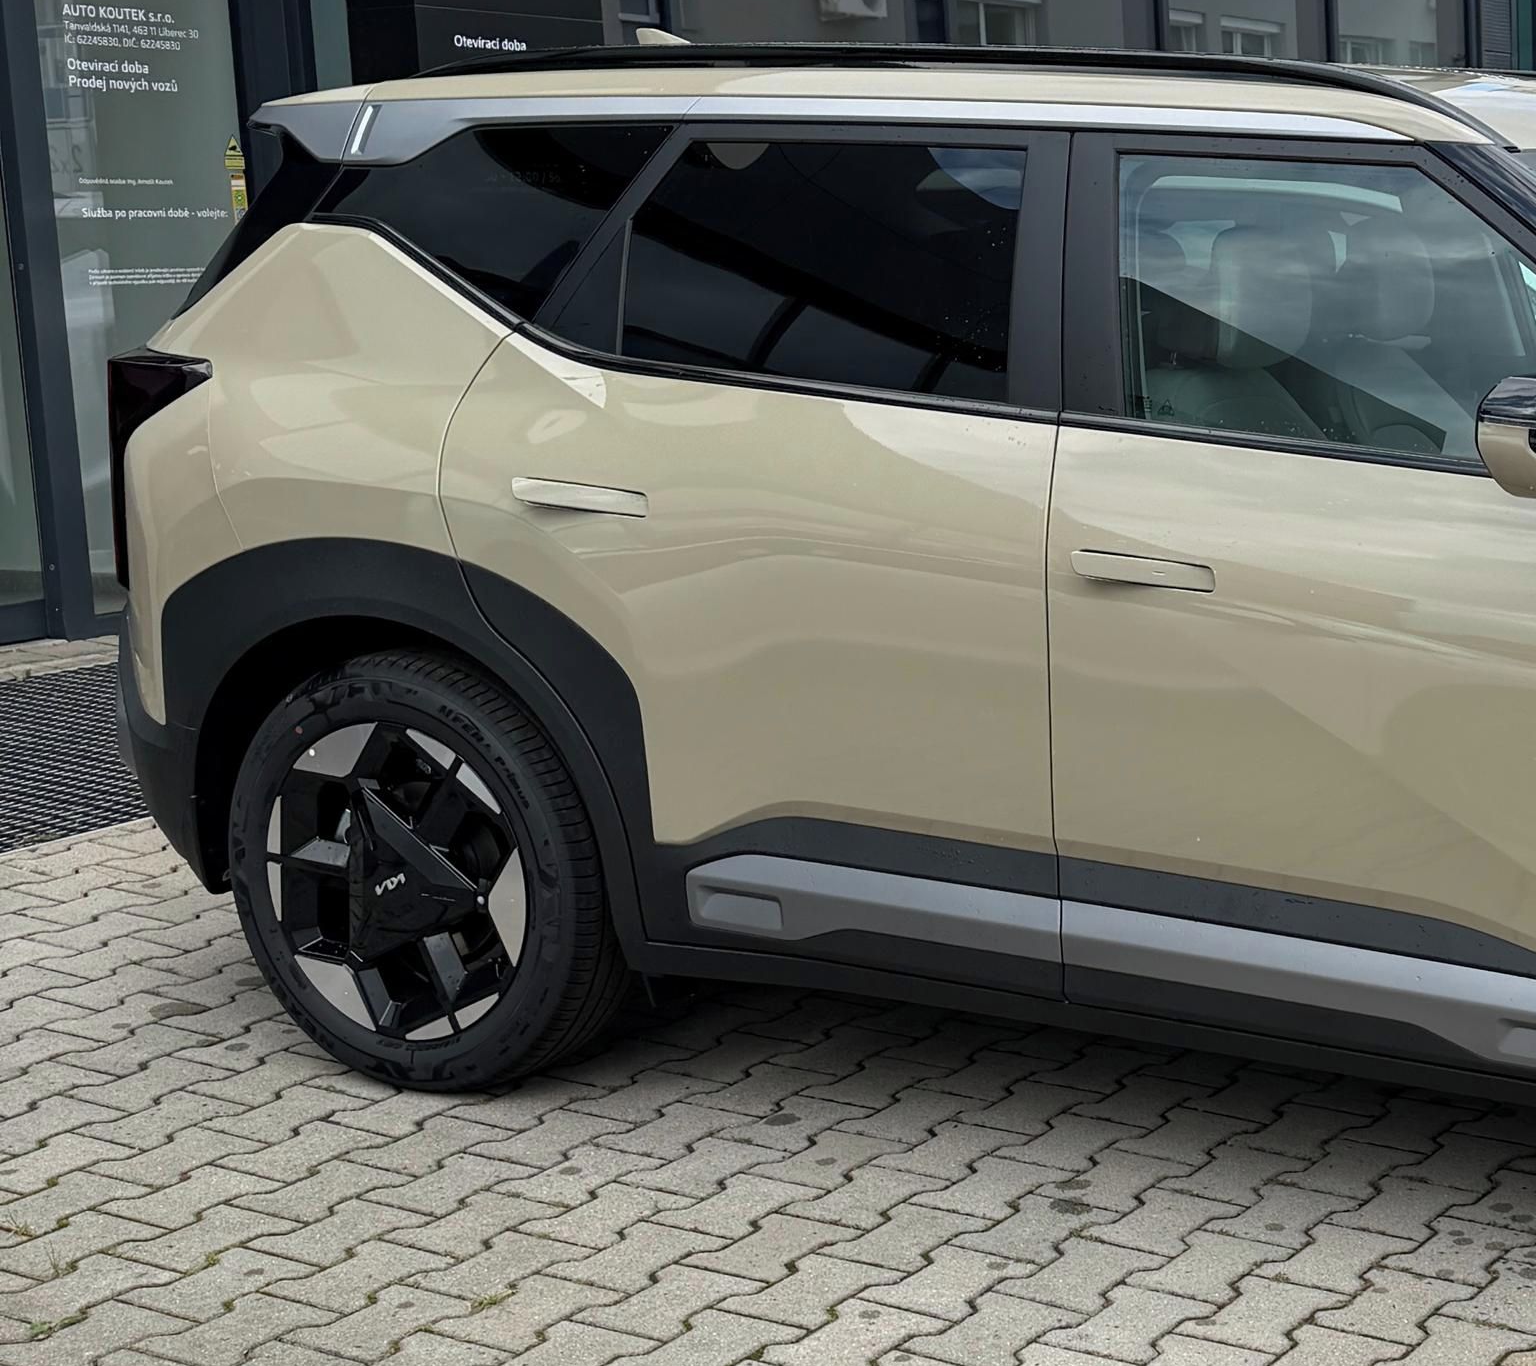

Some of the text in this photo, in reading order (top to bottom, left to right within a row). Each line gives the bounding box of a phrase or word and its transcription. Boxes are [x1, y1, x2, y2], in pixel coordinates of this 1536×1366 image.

[62, 3, 175, 24] AUTO KOUTEK s.r.o.
[63, 20, 112, 33] Tanvaldská
[132, 25, 148, 36] 463
[158, 27, 187, 38] Liberec
[188, 29, 199, 39] 30
[140, 38, 181, 51] 62245830
[501, 38, 527, 51] doba
[121, 60, 149, 74] doba
[68, 75, 178, 93] Prodej nových vozů
[81, 207, 113, 218] Služba
[115, 209, 128, 219] po
[128, 208, 166, 219] pracovní
[167, 208, 190, 218] době
[196, 208, 229, 219] volejte:
[375, 873, 406, 896] KIA
